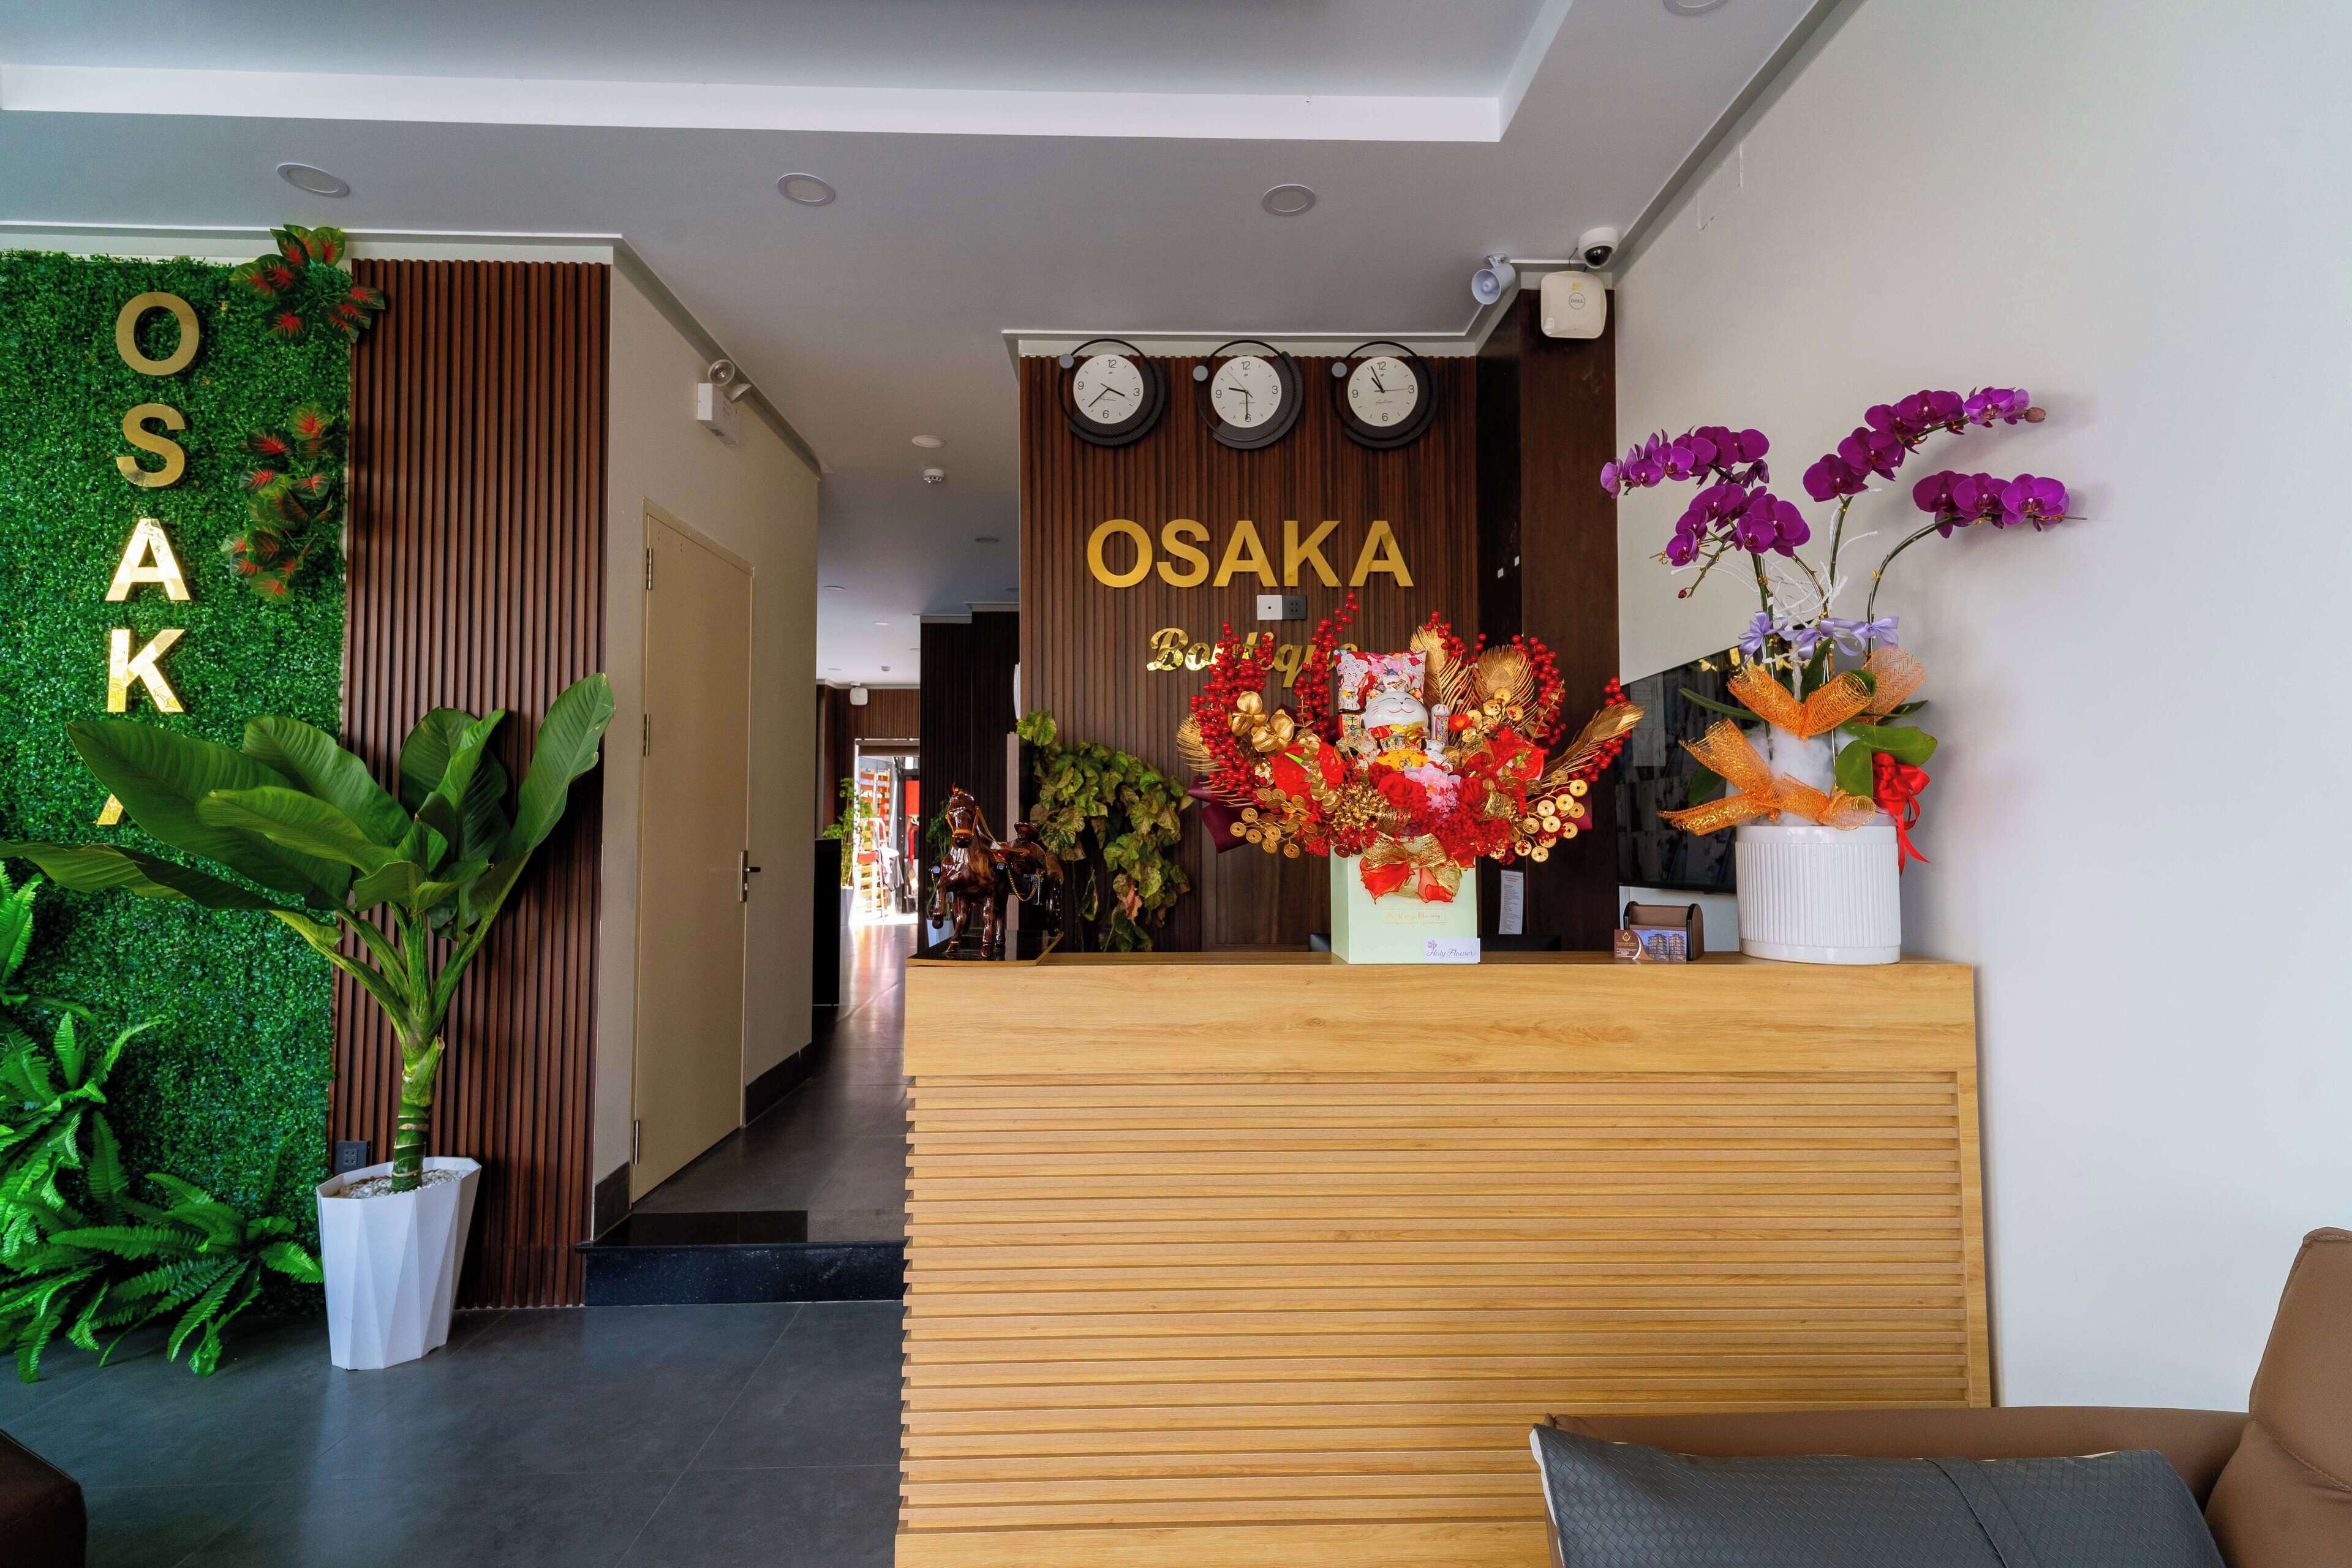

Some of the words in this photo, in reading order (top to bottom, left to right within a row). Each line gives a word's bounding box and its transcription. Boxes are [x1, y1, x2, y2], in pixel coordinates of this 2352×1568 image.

[1107, 359, 1117, 369] 12
[1241, 361, 1250, 370] 12
[1377, 361, 1387, 371] 12
[1077, 381, 1084, 390] 9
[1272, 385, 1278, 394] 3
[1408, 385, 1415, 394] 3
[1133, 388, 1140, 397] 3
[1215, 390, 1222, 399] 9
[1352, 390, 1359, 398] 9
[1102, 410, 1109, 419] 6
[1382, 413, 1389, 421] 6
[1087, 519, 1414, 588] OSAKA
[96, 292, 200, 826] OSAK
